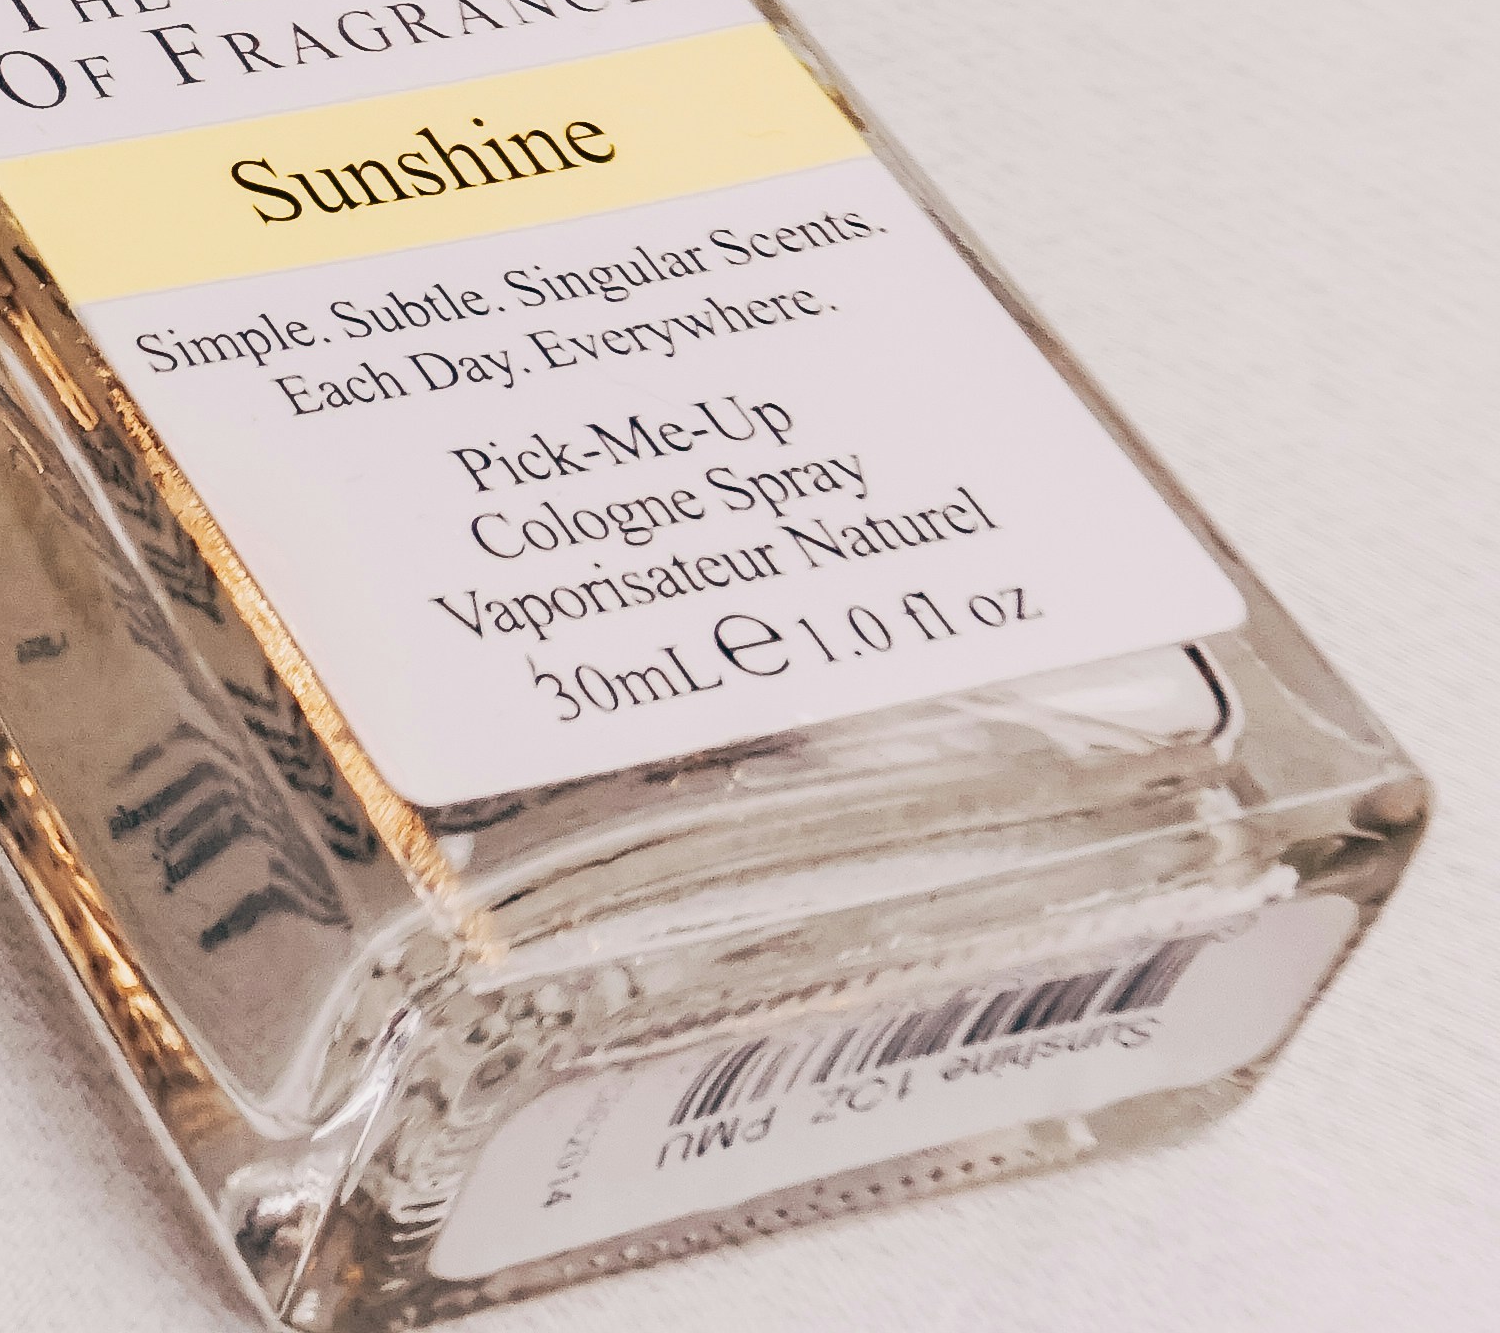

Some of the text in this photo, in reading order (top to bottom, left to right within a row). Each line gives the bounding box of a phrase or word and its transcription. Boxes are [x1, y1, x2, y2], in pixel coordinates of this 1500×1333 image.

[230, 116, 617, 225] Sunshine
[135, 206, 890, 374] Simple. Subtle. Singular Scents.
[271, 281, 841, 417] Each Day. Everywhere.
[448, 396, 794, 494] Pick-Me-Up
[469, 453, 873, 561] Cologne Spray
[428, 485, 1007, 642] Vaporisateur Naturel
[531, 644, 725, 724] 30mL
[796, 603, 895, 666] 1.0
[901, 589, 960, 645] fl
[966, 585, 1046, 630] oz
